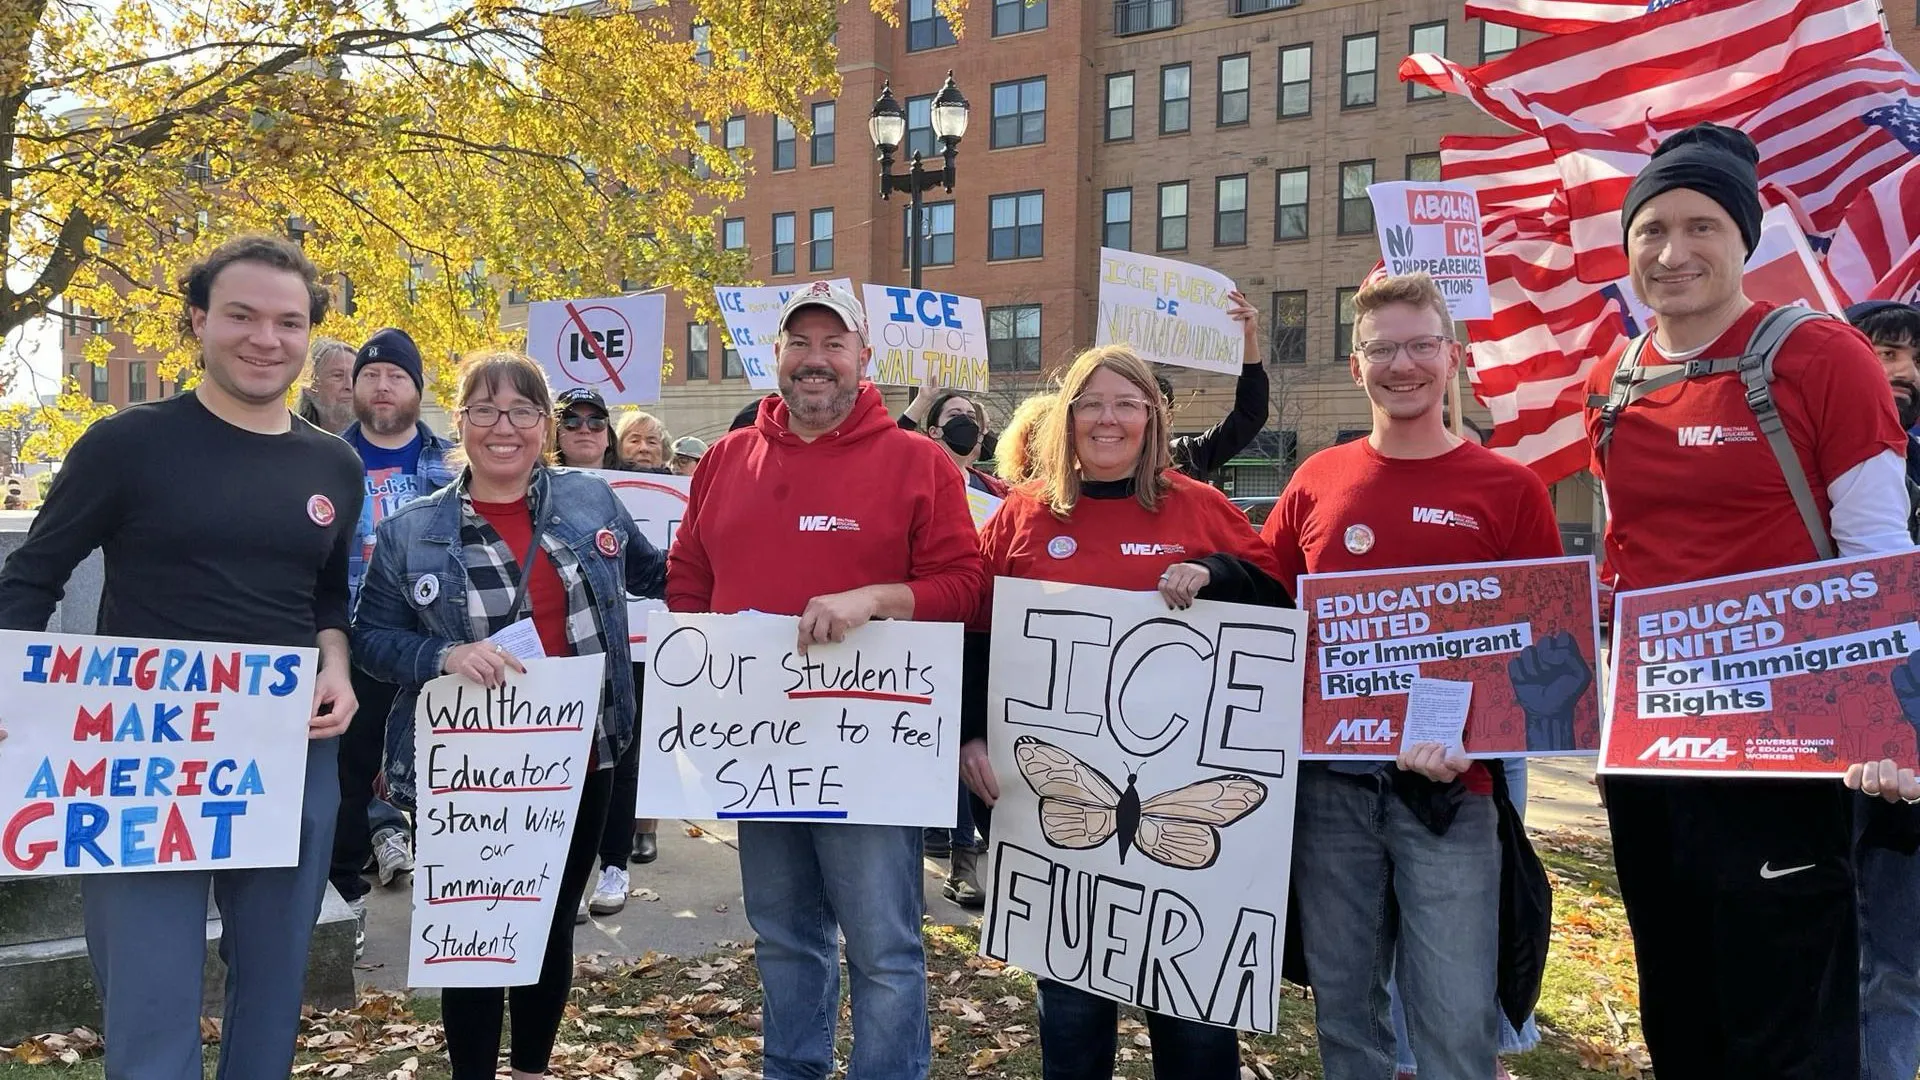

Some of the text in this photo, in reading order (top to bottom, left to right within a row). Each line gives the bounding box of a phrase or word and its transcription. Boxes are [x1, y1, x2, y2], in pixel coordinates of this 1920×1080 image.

[1386, 224, 1413, 257] NO
[1103, 259, 1159, 292] ICE
[719, 291, 745, 313] ICE
[886, 287, 963, 330] ICE
[1156, 297, 1179, 316] DE
[570, 329, 624, 362] ICE
[731, 327, 754, 346] ICE
[883, 322, 976, 350] OUT OF
[744, 357, 765, 378] ICE
[872, 350, 989, 392] WALTHAM
[1678, 425, 1724, 446] WEA
[368, 476, 417, 494] bolish
[799, 515, 837, 532] WEA
[1412, 506, 1455, 527] WEA
[1120, 543, 1164, 555] WEA
[1316, 576, 1501, 620] EDUCATORS
[1638, 571, 1879, 639] EDUCATORS
[1318, 611, 1431, 644] UNITED
[1639, 620, 1785, 664] UNITED
[653, 626, 757, 696] Our
[1325, 628, 1522, 669] For Immigrant
[1645, 629, 1910, 688] For Immigrant
[22, 644, 301, 697] IMMIGRANTS
[1326, 667, 1414, 697] Rights
[426, 685, 585, 731] Waltham
[1004, 607, 1296, 778] ICE
[1646, 687, 1767, 717] Rights
[73, 702, 219, 743] MAKE
[658, 706, 942, 757] deserve to feel
[1326, 718, 1399, 745] MTA
[1637, 737, 1740, 761] MTA
[1744, 753, 1796, 761] WORKERS
[1745, 746, 1818, 754] of EDUCATION
[1755, 738, 1798, 746] DIVERSE
[1799, 738, 1834, 746] UNION
[24, 756, 266, 799] AMERICA
[427, 744, 572, 790] Educators
[716, 759, 843, 809] SAFE
[2, 800, 249, 871] GREAT
[480, 843, 514, 861] our
[423, 862, 551, 911] Immigrant
[422, 923, 519, 961] Students
[987, 841, 1277, 1034] FUERA
